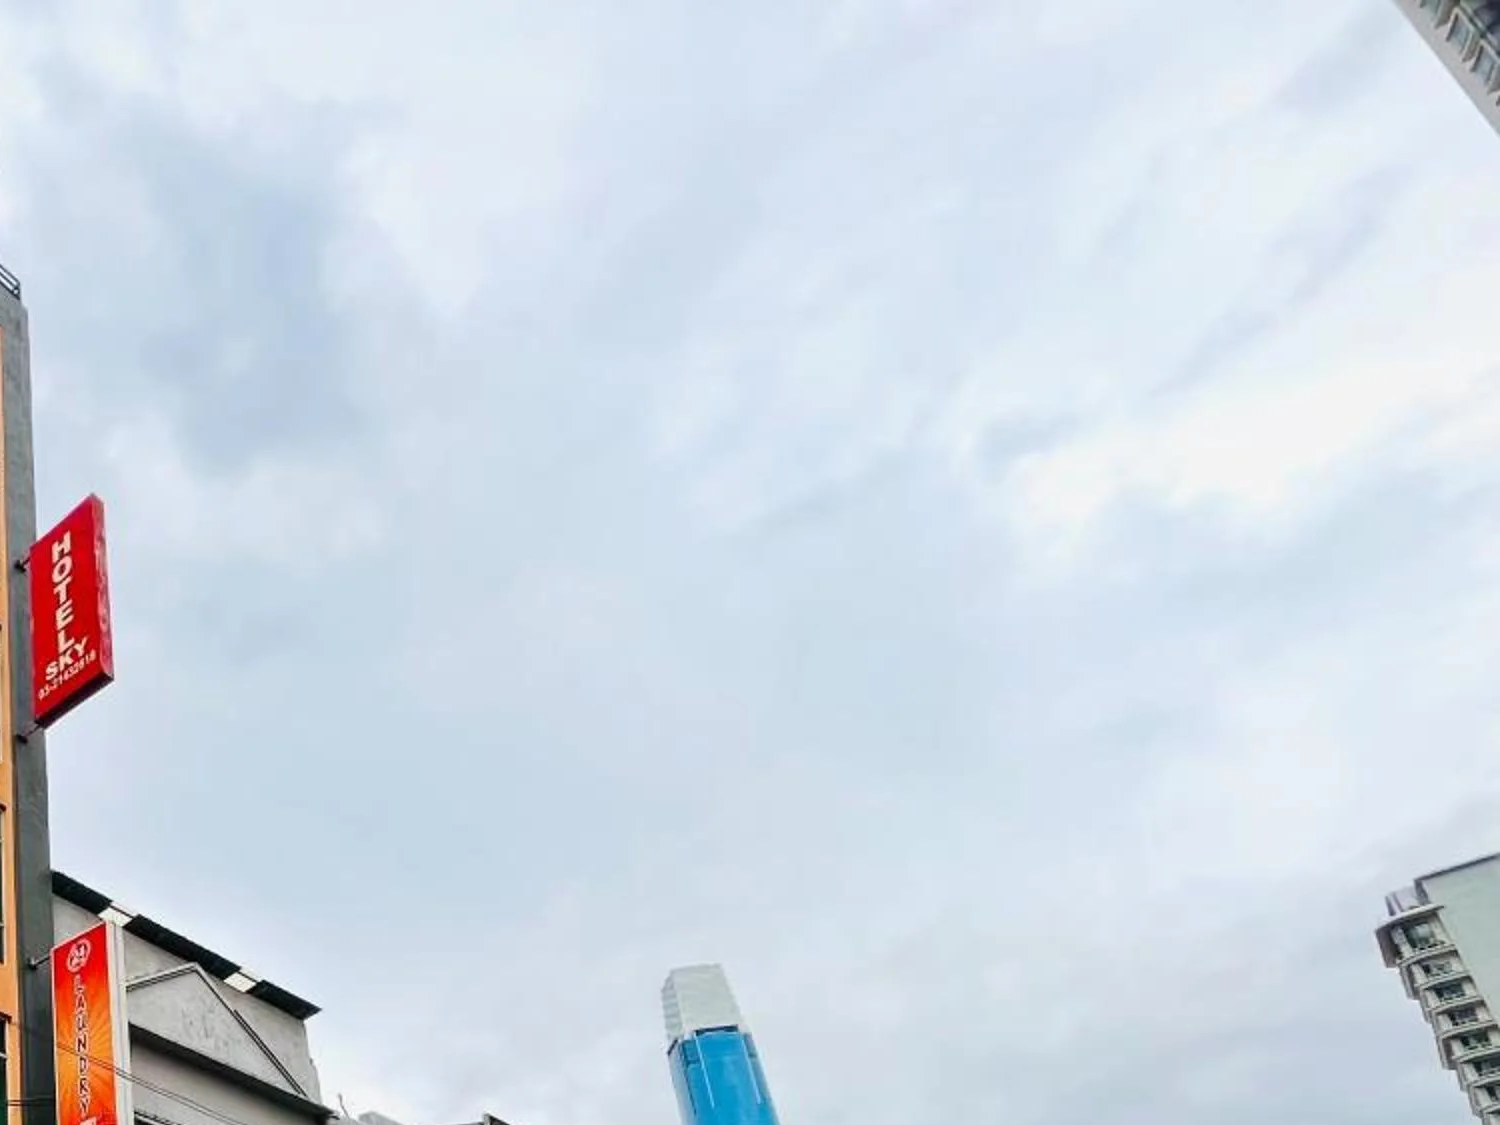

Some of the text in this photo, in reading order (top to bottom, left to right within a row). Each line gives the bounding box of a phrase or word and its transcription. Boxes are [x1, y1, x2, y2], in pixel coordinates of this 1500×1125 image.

[52, 530, 75, 655] HOTEL
[45, 637, 87, 681] SKY
[73, 975, 91, 1116] LAUNDRY
